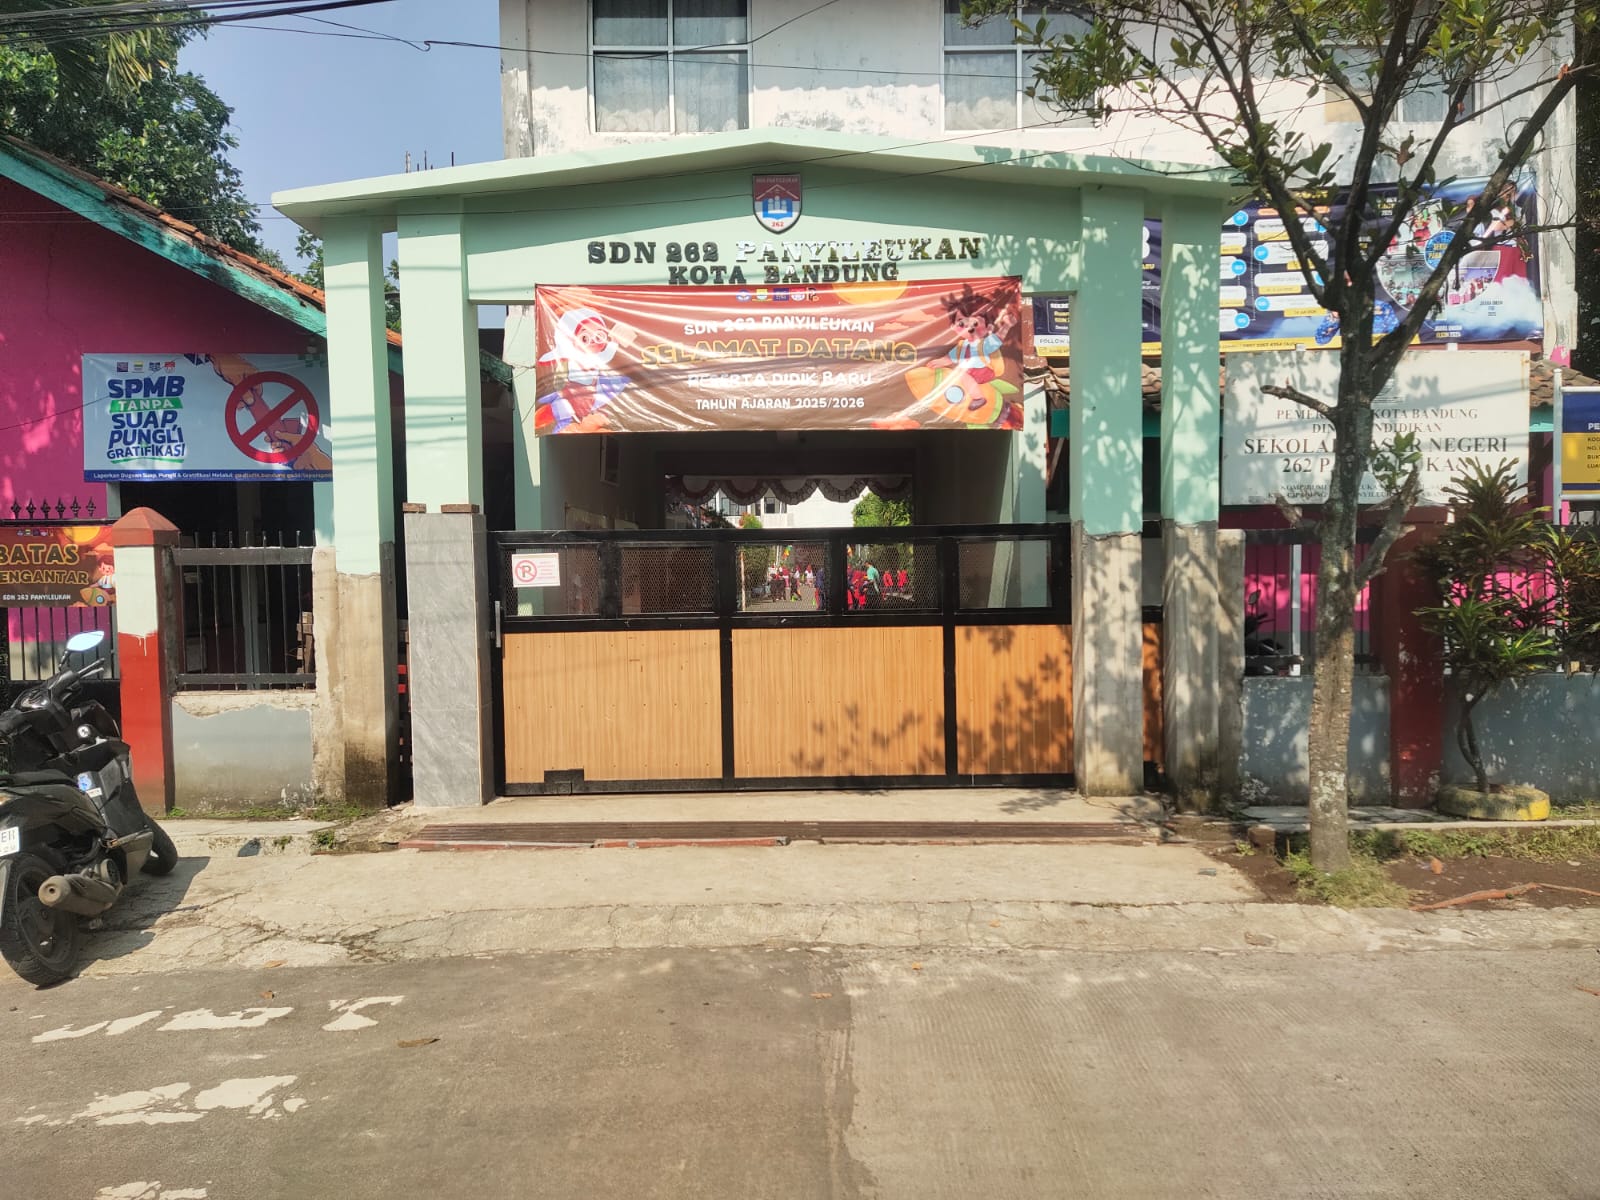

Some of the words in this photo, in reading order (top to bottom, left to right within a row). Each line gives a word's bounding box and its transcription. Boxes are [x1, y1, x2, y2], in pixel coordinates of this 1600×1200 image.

[587, 241, 657, 264] SDN
[665, 241, 720, 263] 262
[735, 237, 982, 263] PANYILEUKAN
[668, 265, 747, 285] KOTA
[763, 263, 900, 284] BANDUNG
[683, 322, 719, 335] SDN
[641, 338, 781, 366] SELAMAT
[787, 338, 918, 365] DATANG
[107, 375, 185, 399] SPMB
[773, 372, 818, 387] DIDIK
[821, 370, 873, 386] BARU
[117, 399, 174, 412] TANPA
[695, 398, 737, 411] TAHUN
[741, 398, 790, 410] AJARAN
[795, 397, 866, 410] 2025/2026
[111, 410, 178, 431] SUAP,
[1412, 408, 1479, 420] BANDUNG
[108, 427, 184, 449] PUNGLI
[1429, 437, 1508, 453] NEGERI
[106, 443, 186, 460] GRATIFIKASI
[1281, 458, 1313, 473] 262
